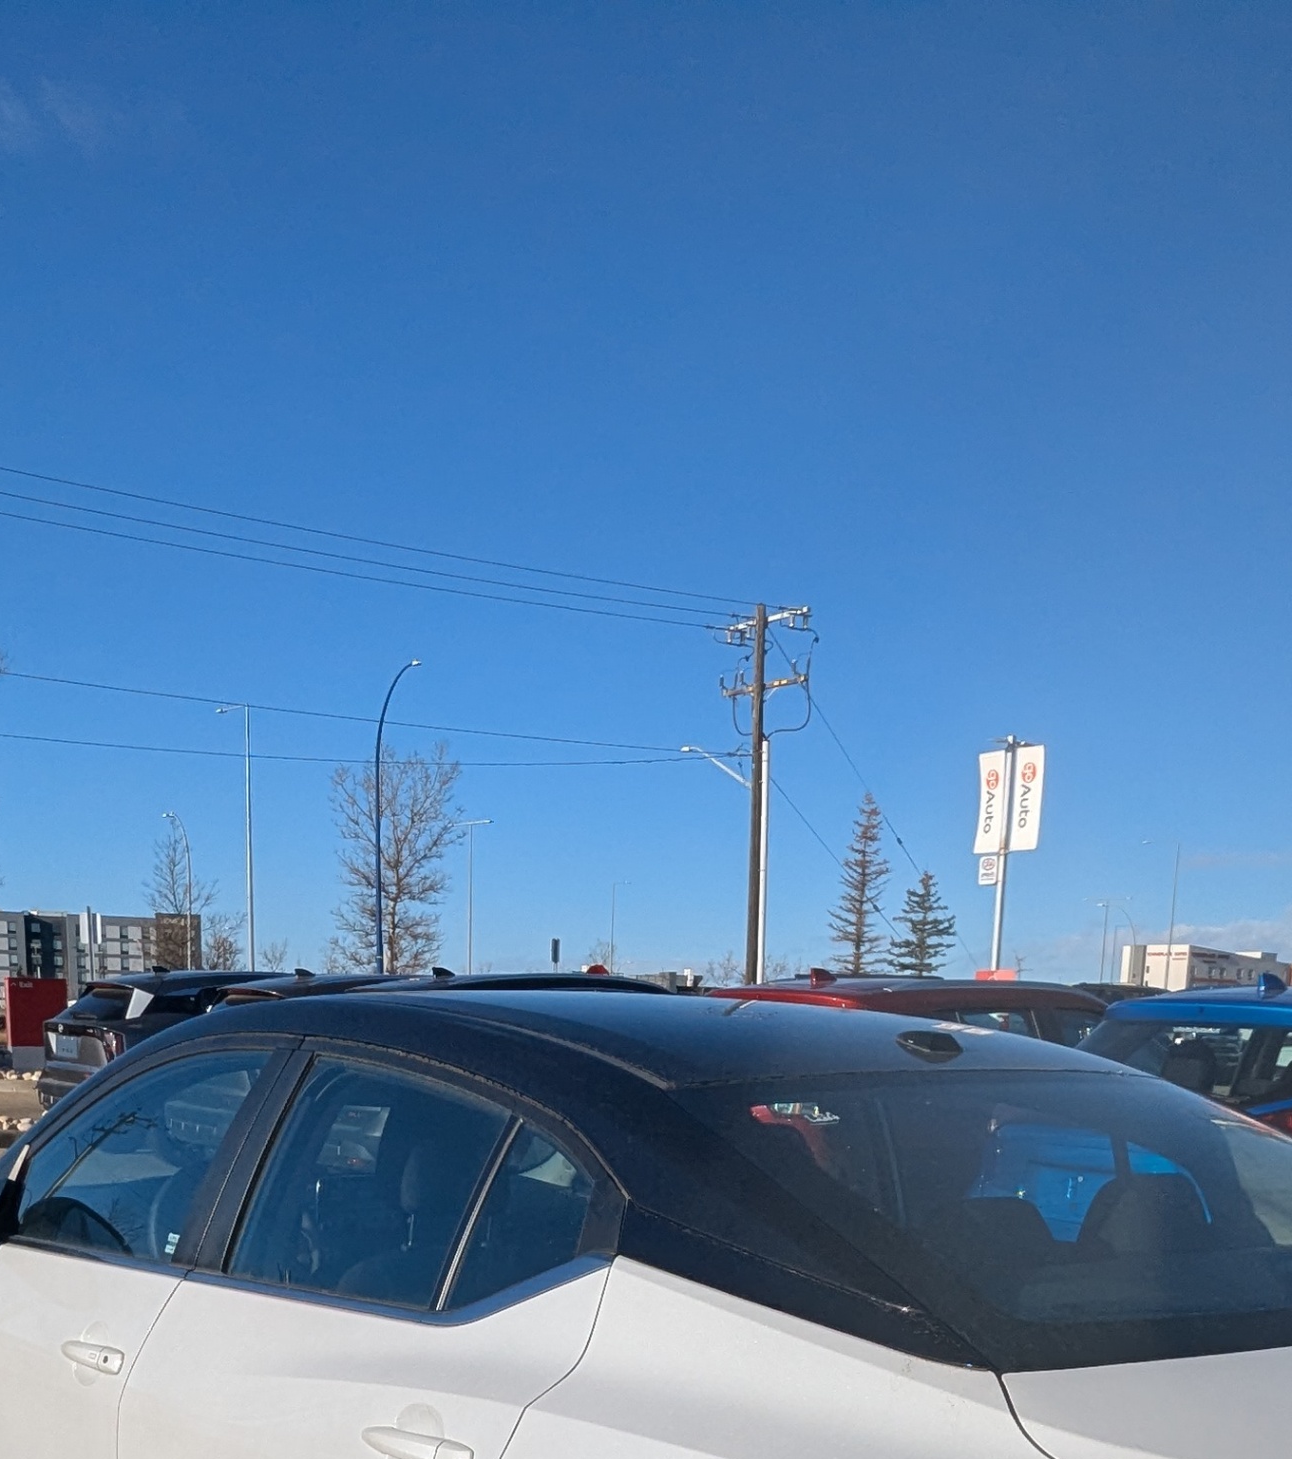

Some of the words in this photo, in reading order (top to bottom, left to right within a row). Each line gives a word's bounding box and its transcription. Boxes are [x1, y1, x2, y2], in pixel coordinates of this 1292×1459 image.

[986, 769, 999, 790] go
[1022, 762, 1036, 783] go
[983, 790, 996, 835] Auto
[1018, 784, 1031, 829] Auto
